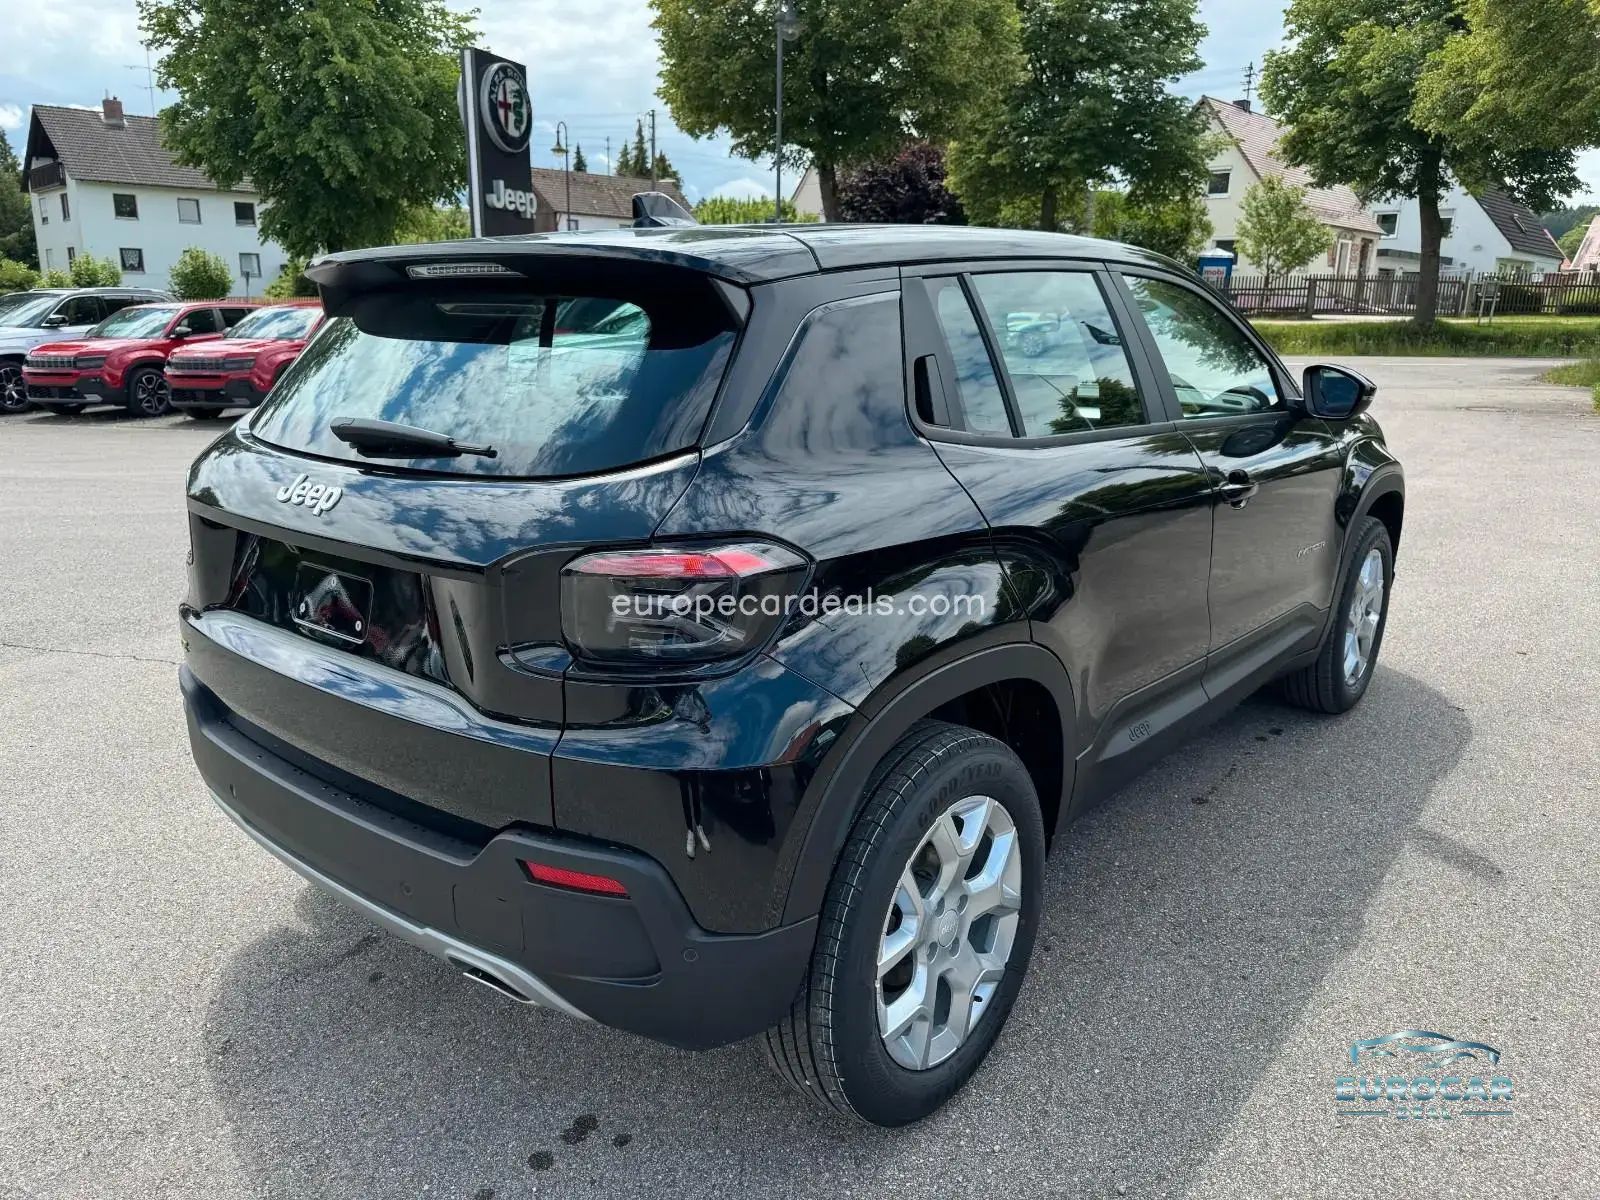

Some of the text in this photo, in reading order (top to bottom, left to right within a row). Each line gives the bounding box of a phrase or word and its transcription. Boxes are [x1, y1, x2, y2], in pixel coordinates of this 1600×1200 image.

[489, 69, 506, 103] ALFA
[486, 179, 538, 219] Jeep
[276, 473, 343, 517] Jeep
[1128, 719, 1151, 742] Jeep
[917, 762, 1003, 830] GOODYEAR
